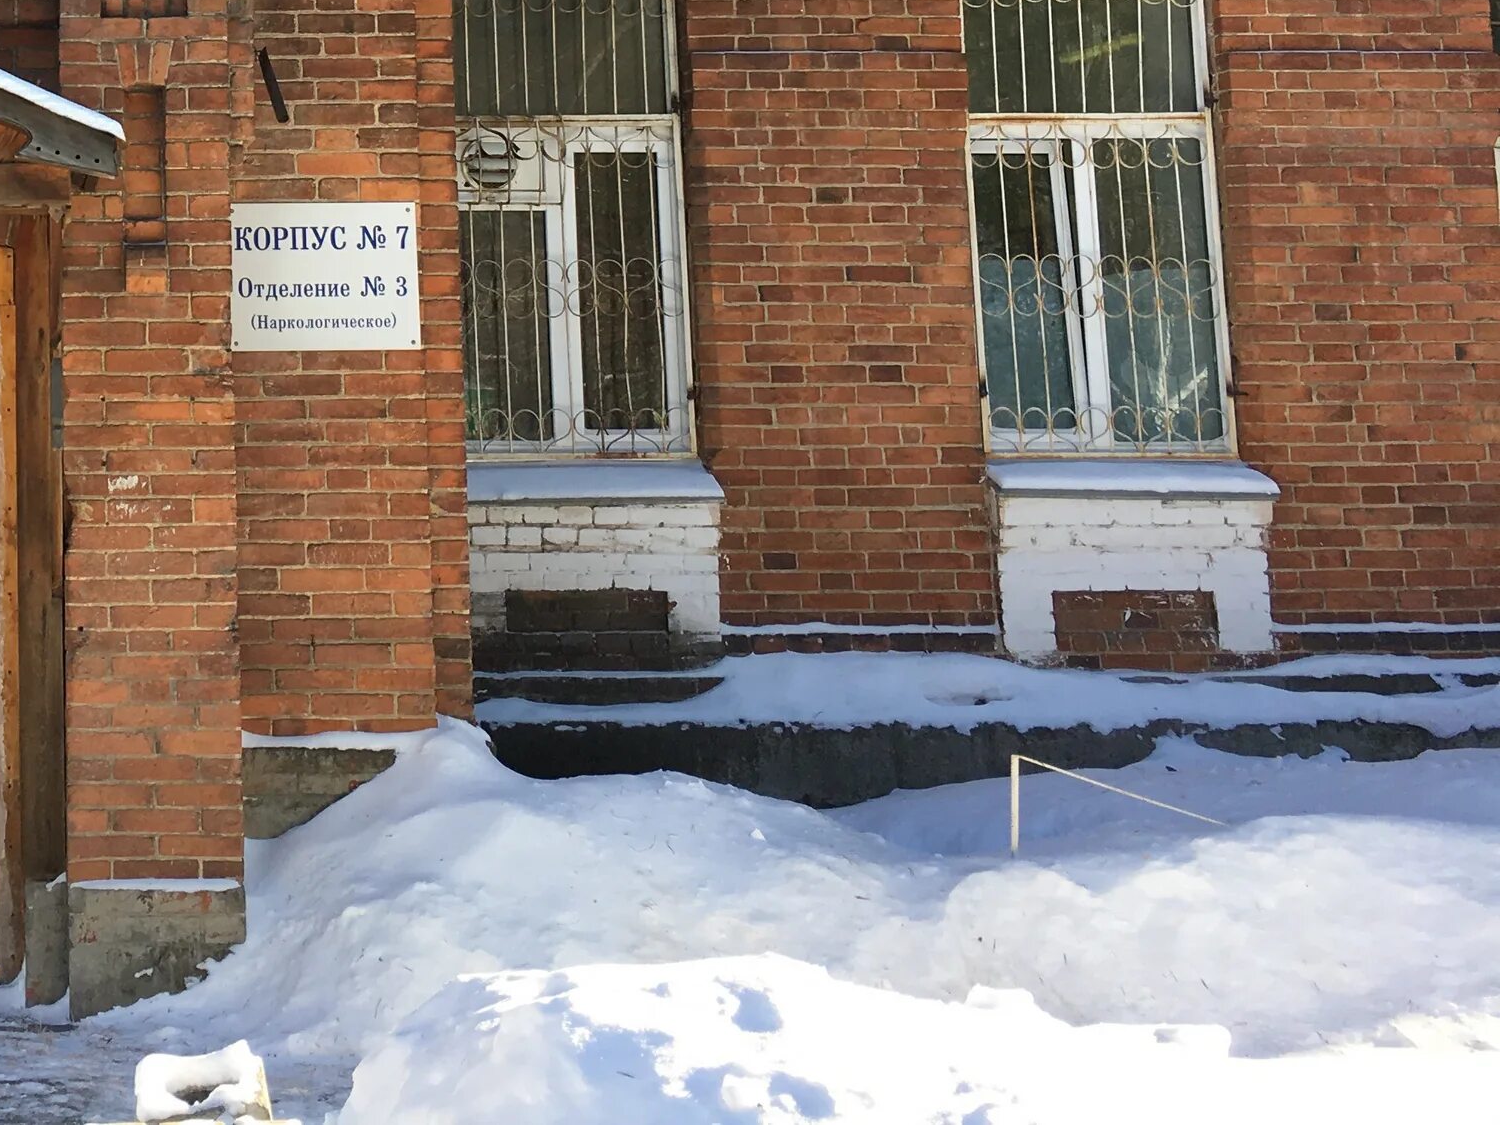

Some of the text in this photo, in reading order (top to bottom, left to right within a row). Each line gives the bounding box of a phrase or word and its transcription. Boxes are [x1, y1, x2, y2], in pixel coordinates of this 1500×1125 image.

[234, 225, 410, 251] КОРПУС № 7
[237, 275, 408, 302] Отделение № 3
[250, 313, 397, 333] (Наркологическое)
